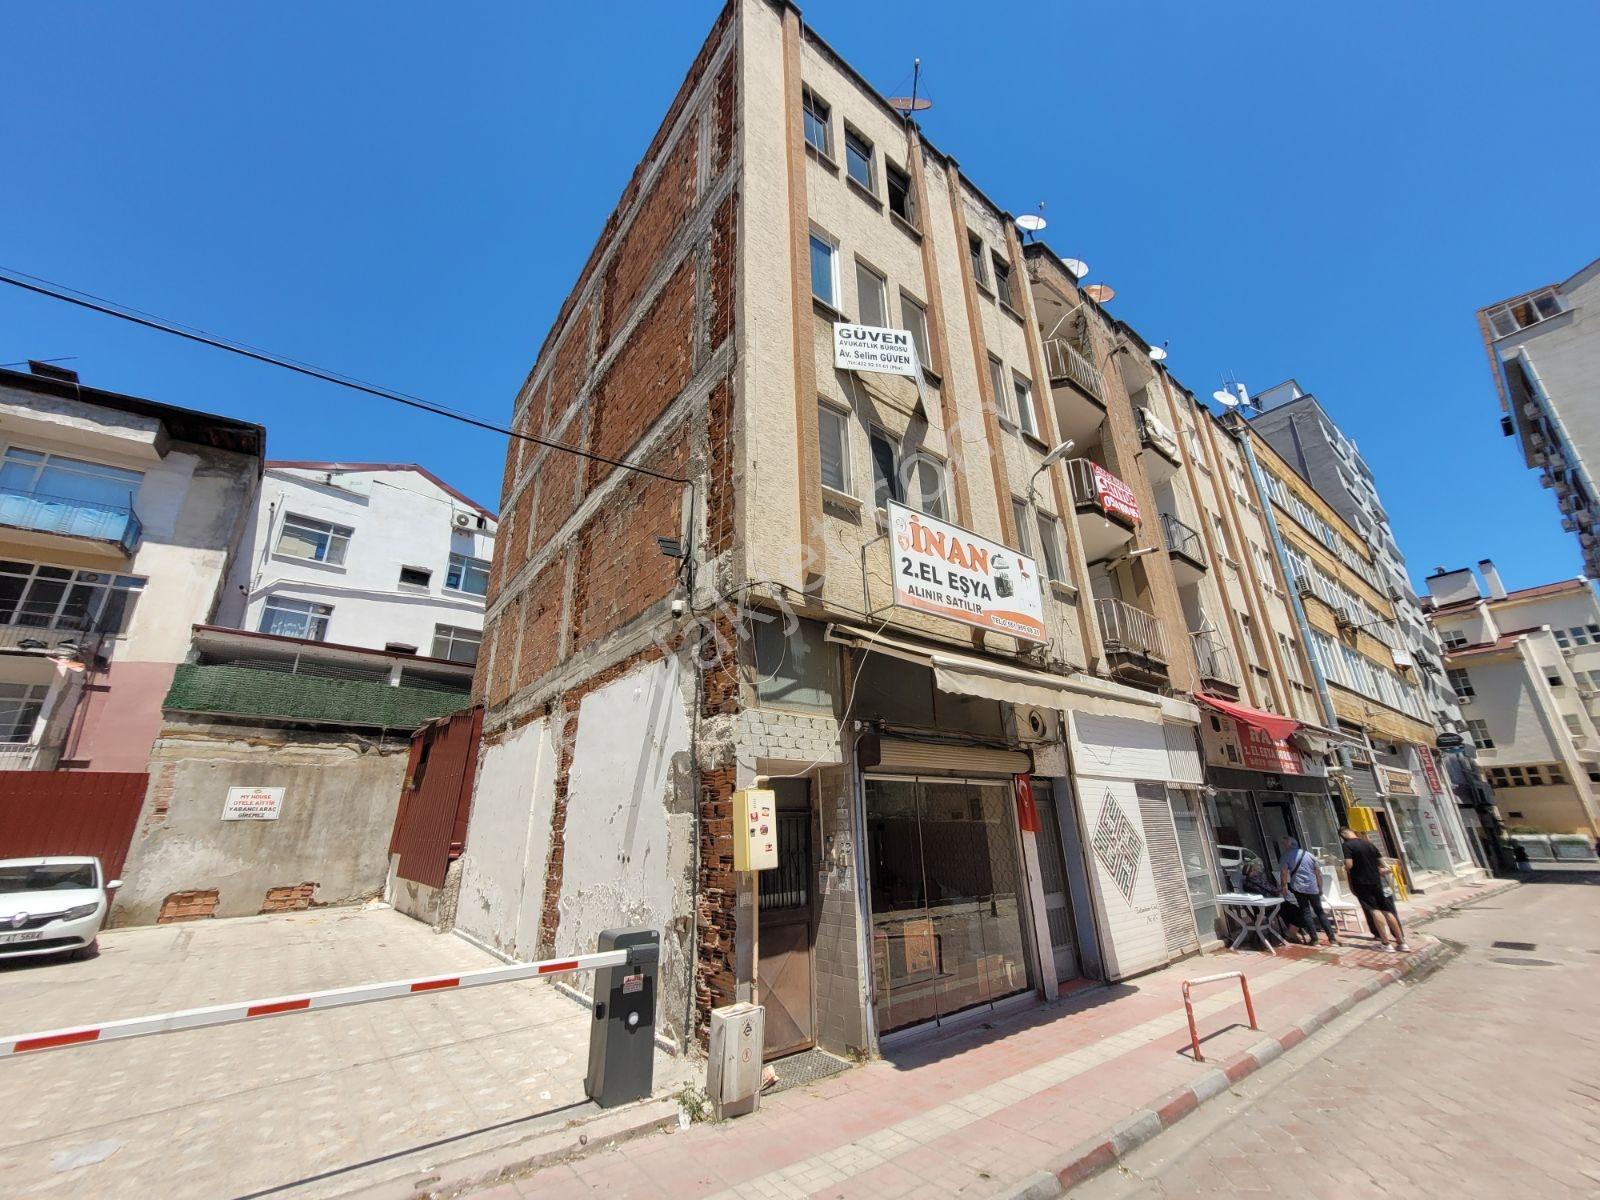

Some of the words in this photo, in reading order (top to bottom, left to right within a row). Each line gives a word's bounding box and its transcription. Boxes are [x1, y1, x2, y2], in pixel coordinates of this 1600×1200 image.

[839, 327, 907, 345] GÜVEN
[839, 340, 878, 349] AVUKATLIK
[880, 344, 908, 353] BÜROSU
[839, 349, 852, 358] Av.
[854, 350, 878, 360] Selim
[880, 351, 910, 364] GÜVEN
[908, 514, 989, 577] İNAN
[901, 557, 943, 586] 2.EL
[948, 571, 992, 602] EŞYA
[908, 585, 943, 605] ALINIR
[945, 594, 983, 615] SATILIR
